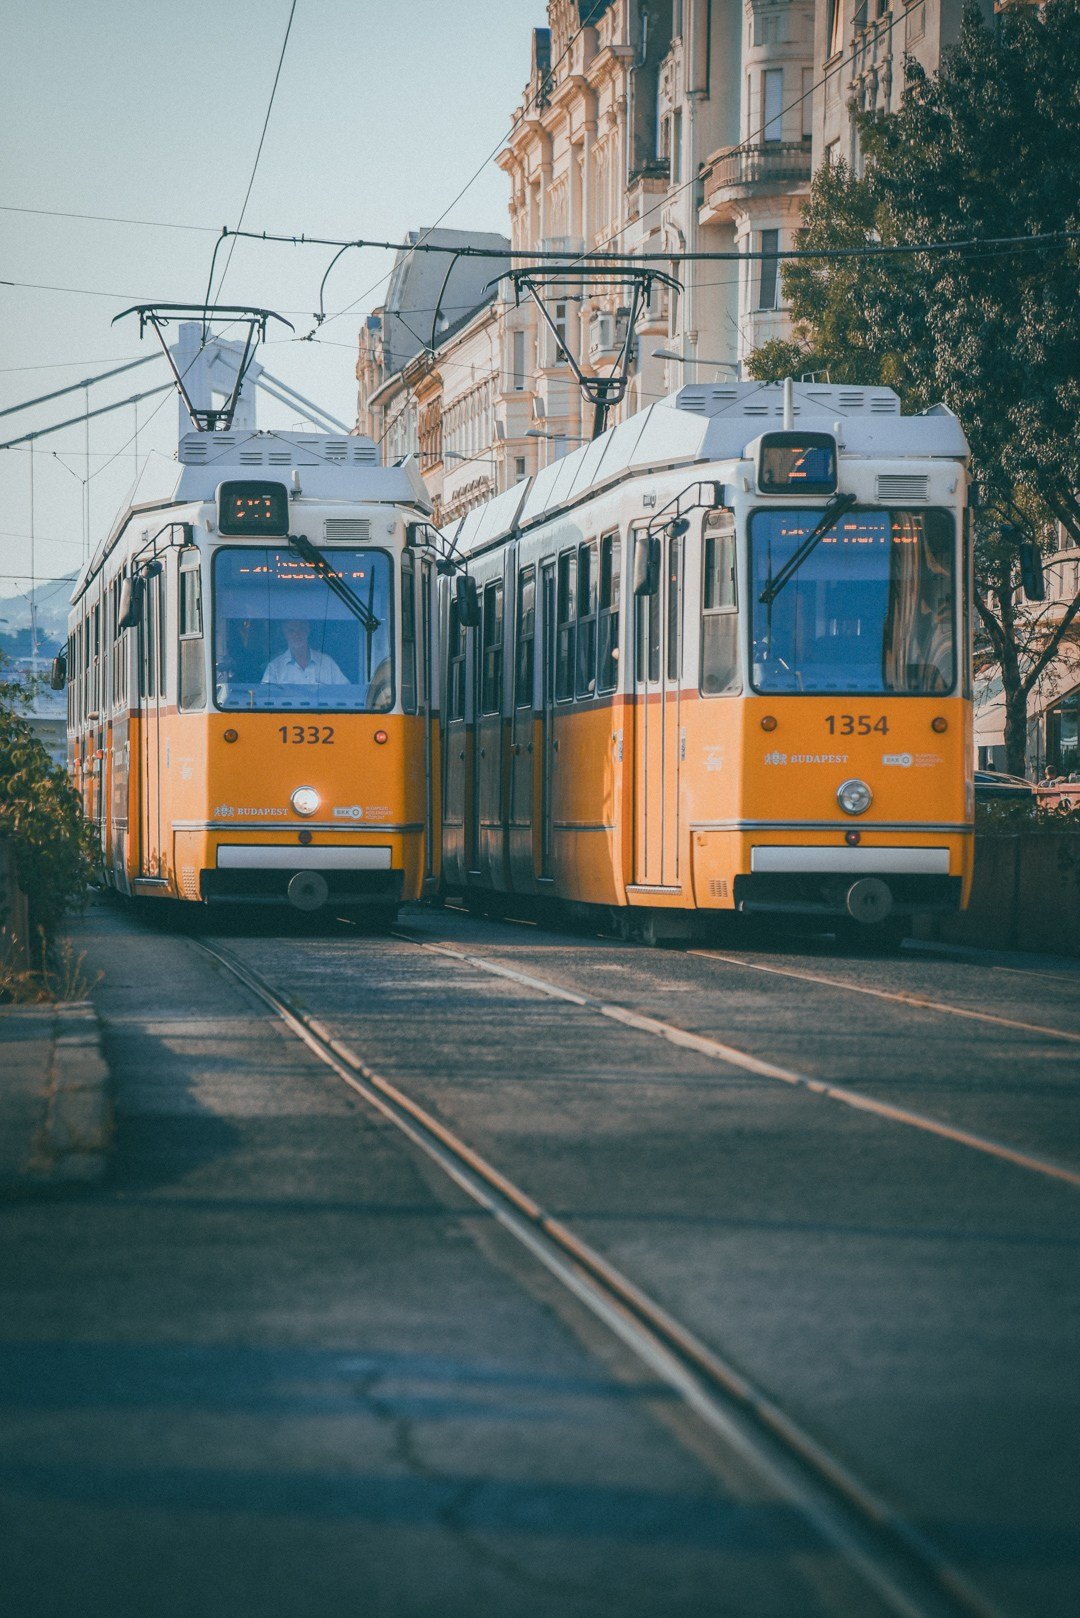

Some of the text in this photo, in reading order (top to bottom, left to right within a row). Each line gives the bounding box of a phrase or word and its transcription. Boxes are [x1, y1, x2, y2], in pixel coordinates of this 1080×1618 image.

[825, 715, 889, 735] 1354
[279, 726, 335, 744] 1332
[791, 755, 849, 763] BUDAPEST
[237, 807, 289, 815] BUDAPEST
